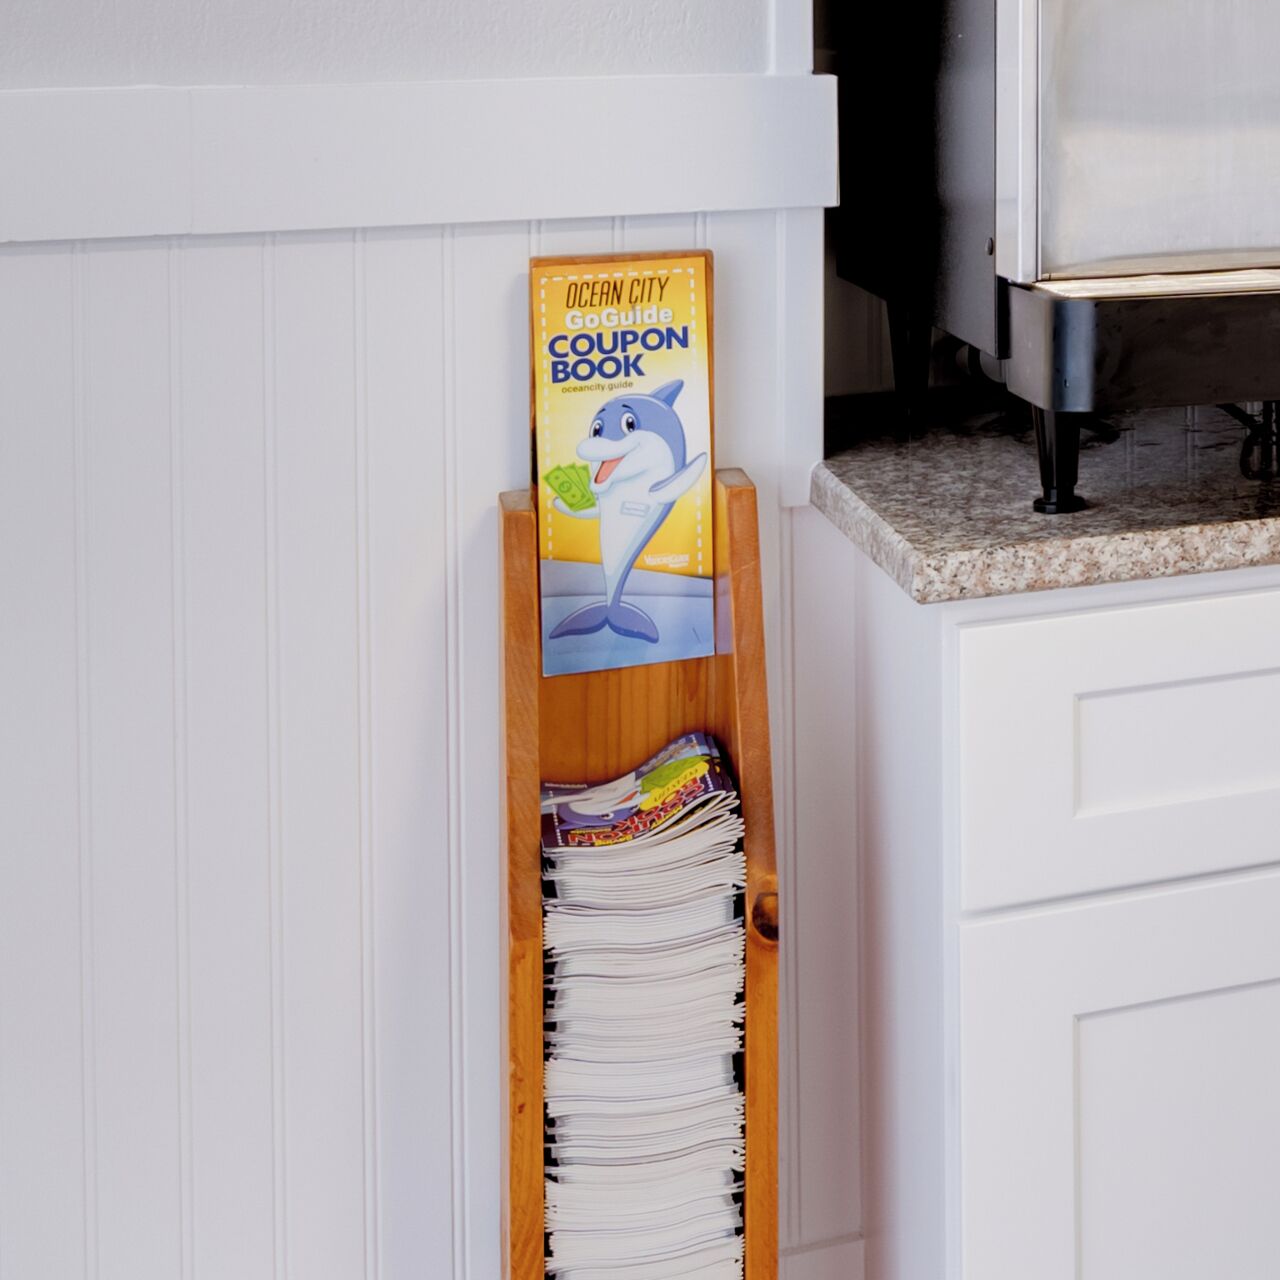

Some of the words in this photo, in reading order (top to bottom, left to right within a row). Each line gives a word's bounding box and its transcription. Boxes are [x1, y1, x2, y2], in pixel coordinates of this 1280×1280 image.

[565, 279, 624, 309] OCEAN
[628, 276, 670, 305] CITY
[565, 304, 674, 330] GoGuide
[548, 326, 689, 359] COUPON
[551, 353, 645, 384] BOOK
[561, 380, 634, 393] oceancity.guide
